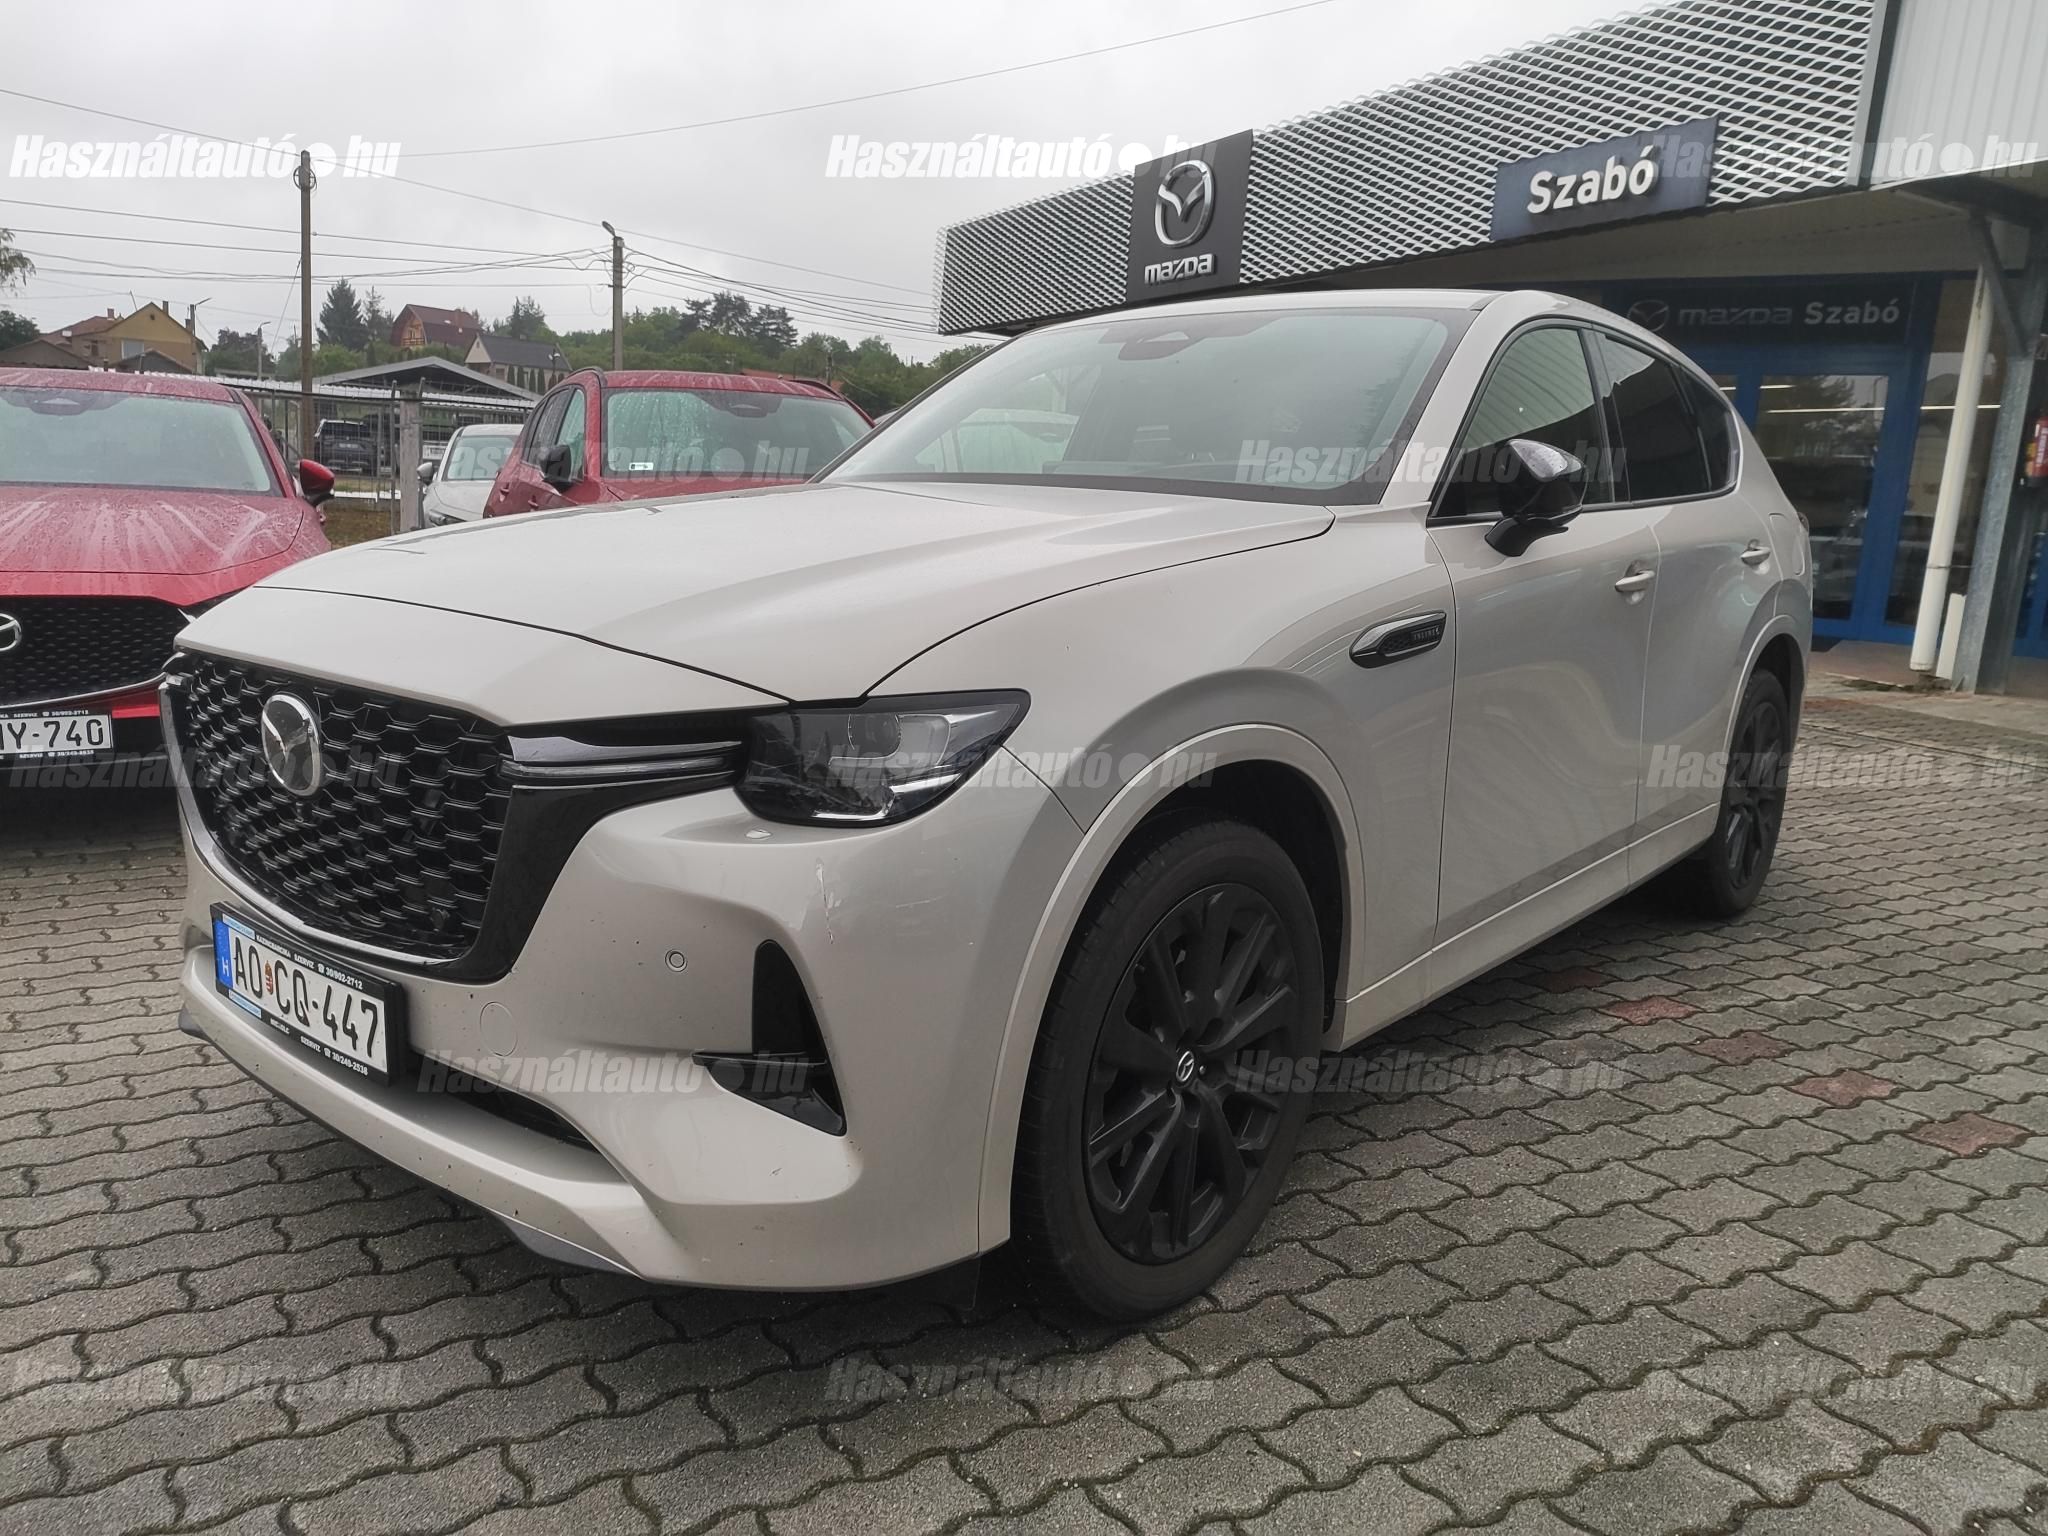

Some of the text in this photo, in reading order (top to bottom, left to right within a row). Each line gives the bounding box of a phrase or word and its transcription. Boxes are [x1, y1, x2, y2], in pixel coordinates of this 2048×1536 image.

[1527, 144, 1654, 214] Szabó
[1144, 253, 1214, 284] mazda
[1678, 298, 1900, 326] mazda Szabó
[0, 719, 104, 750] Y-740
